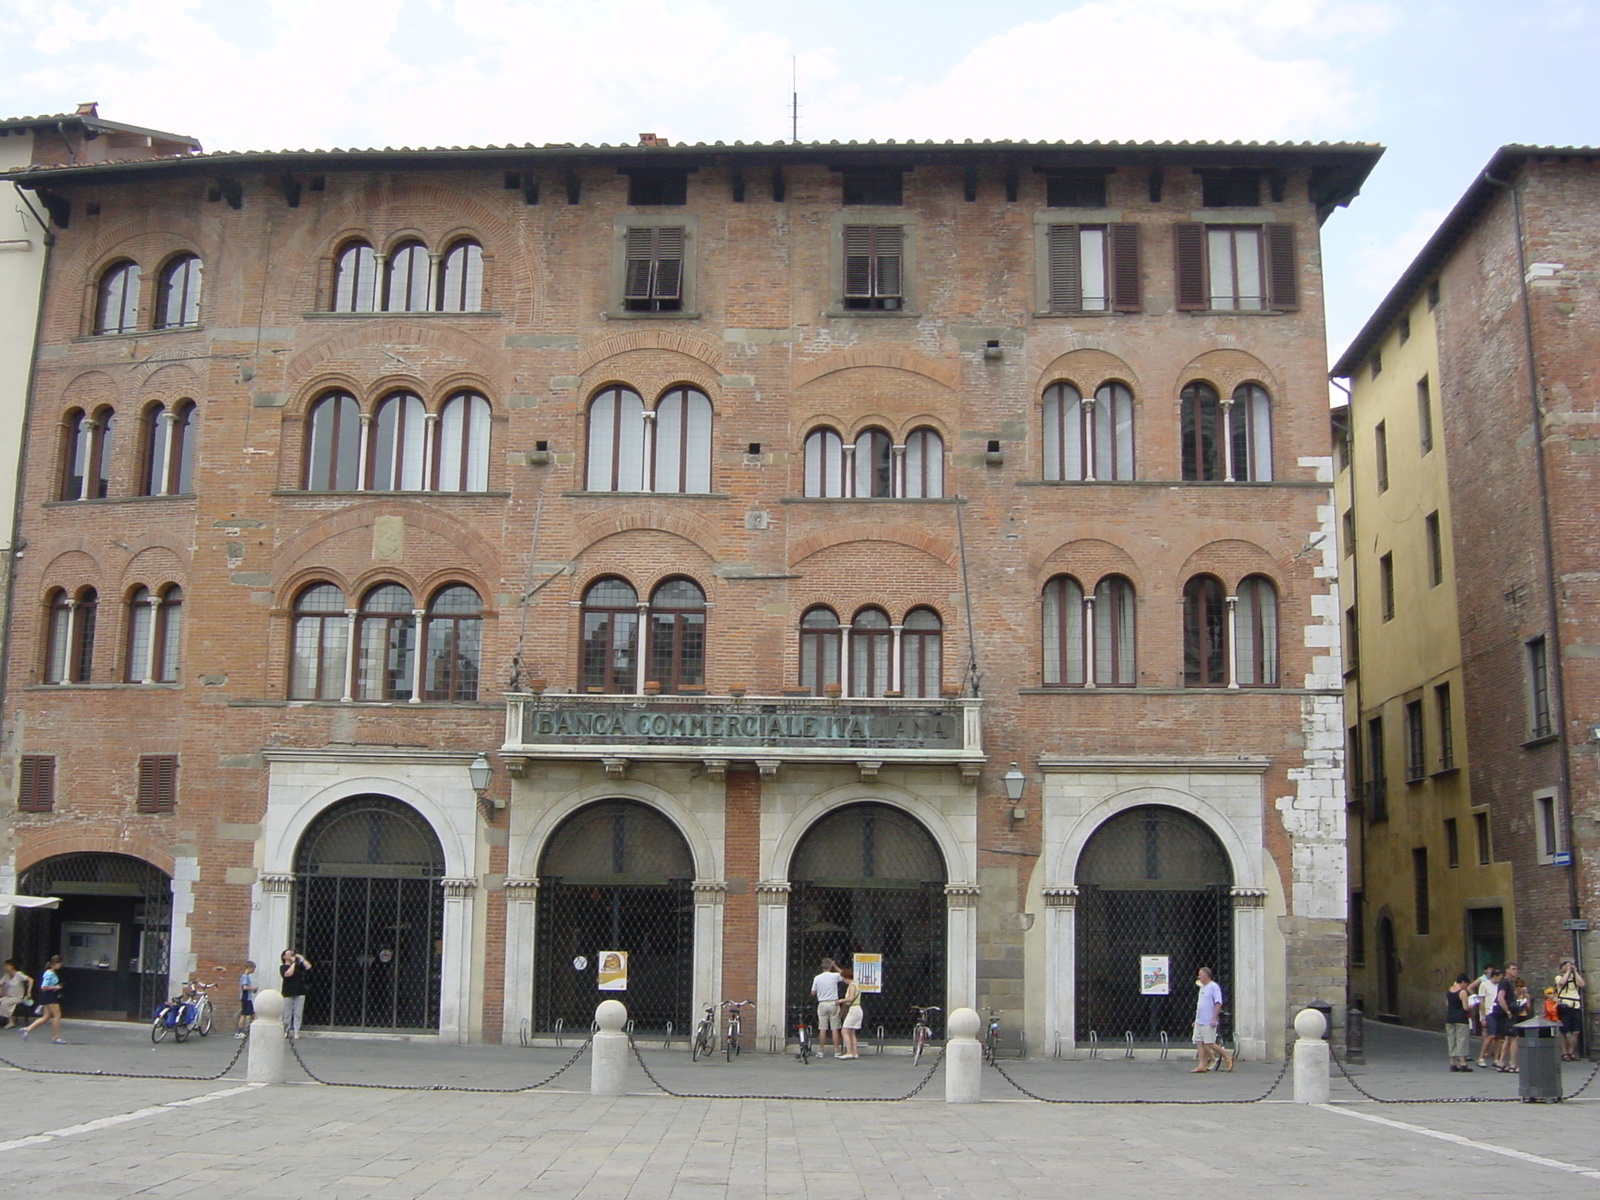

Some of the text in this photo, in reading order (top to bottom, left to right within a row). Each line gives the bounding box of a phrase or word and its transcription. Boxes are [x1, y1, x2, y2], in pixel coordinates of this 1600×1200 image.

[537, 712, 949, 740] BANCA COMMERCIALE ITALIANA
